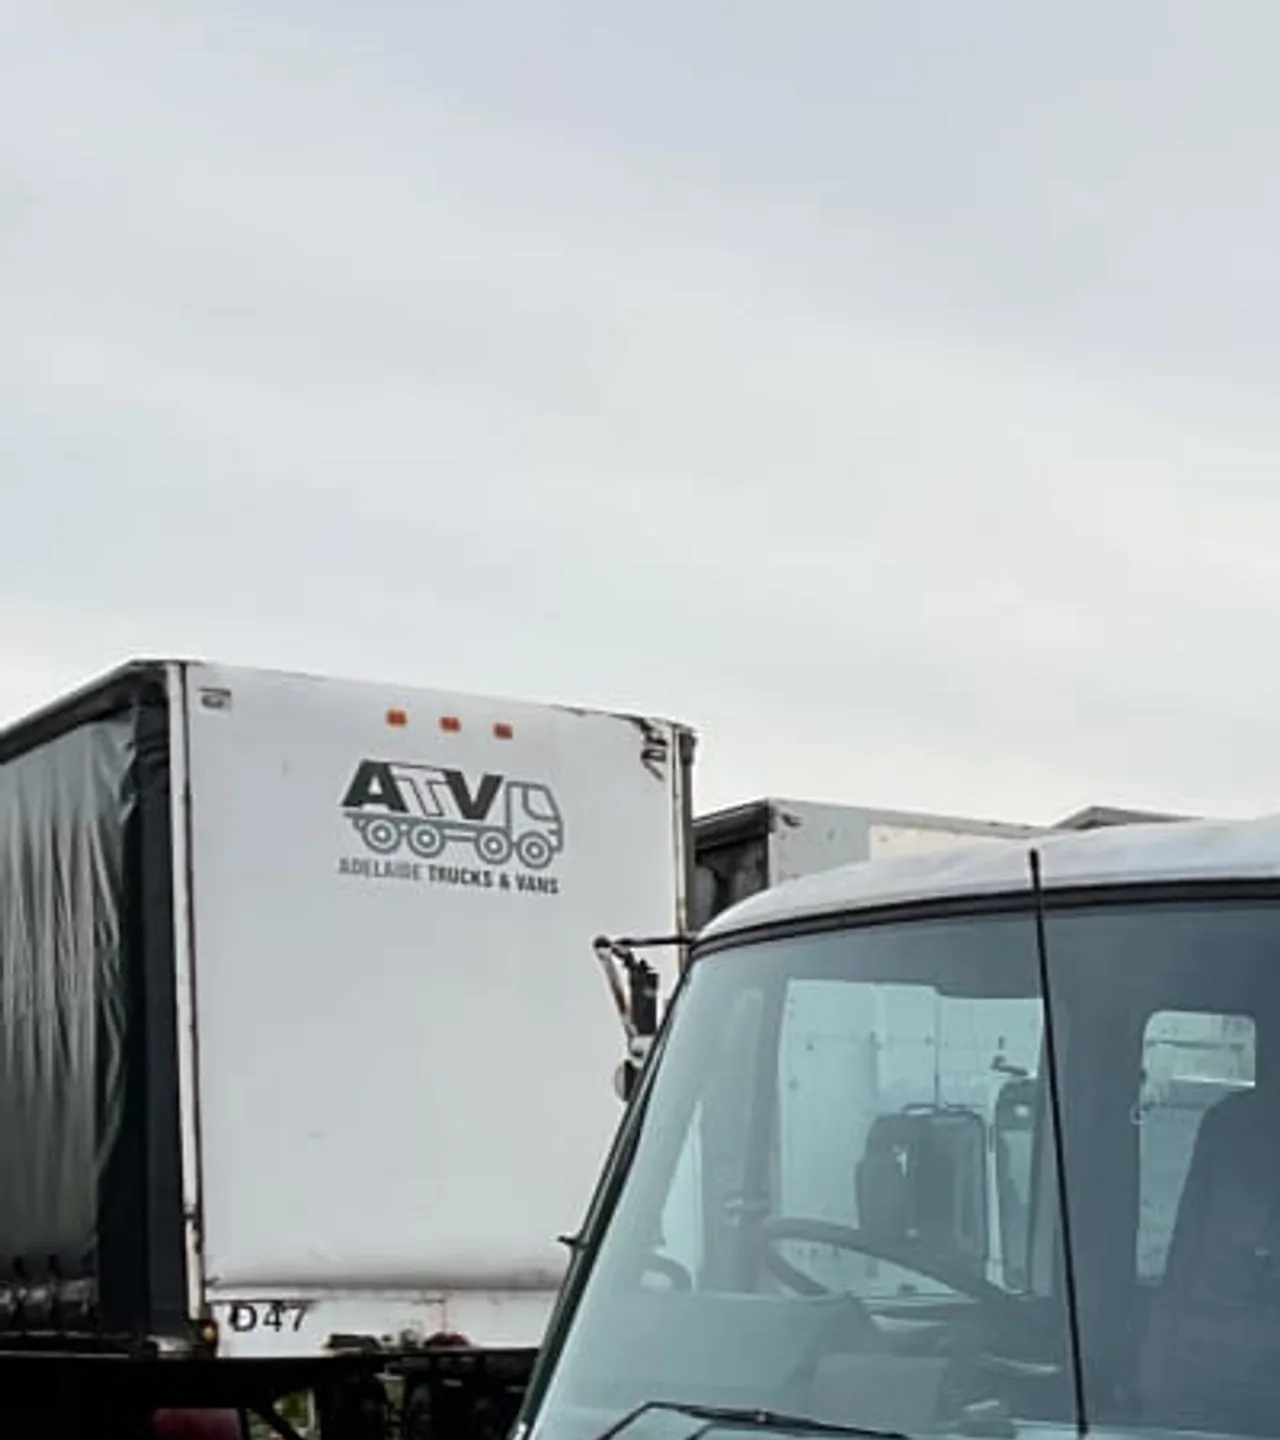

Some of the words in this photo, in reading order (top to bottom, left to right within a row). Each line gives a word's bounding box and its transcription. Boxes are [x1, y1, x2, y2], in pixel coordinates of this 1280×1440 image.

[341, 759, 504, 821] ATV
[428, 864, 494, 888] TRUCKS
[499, 872, 511, 892] &
[514, 874, 560, 895] VANS
[228, 1300, 308, 1332] D47
